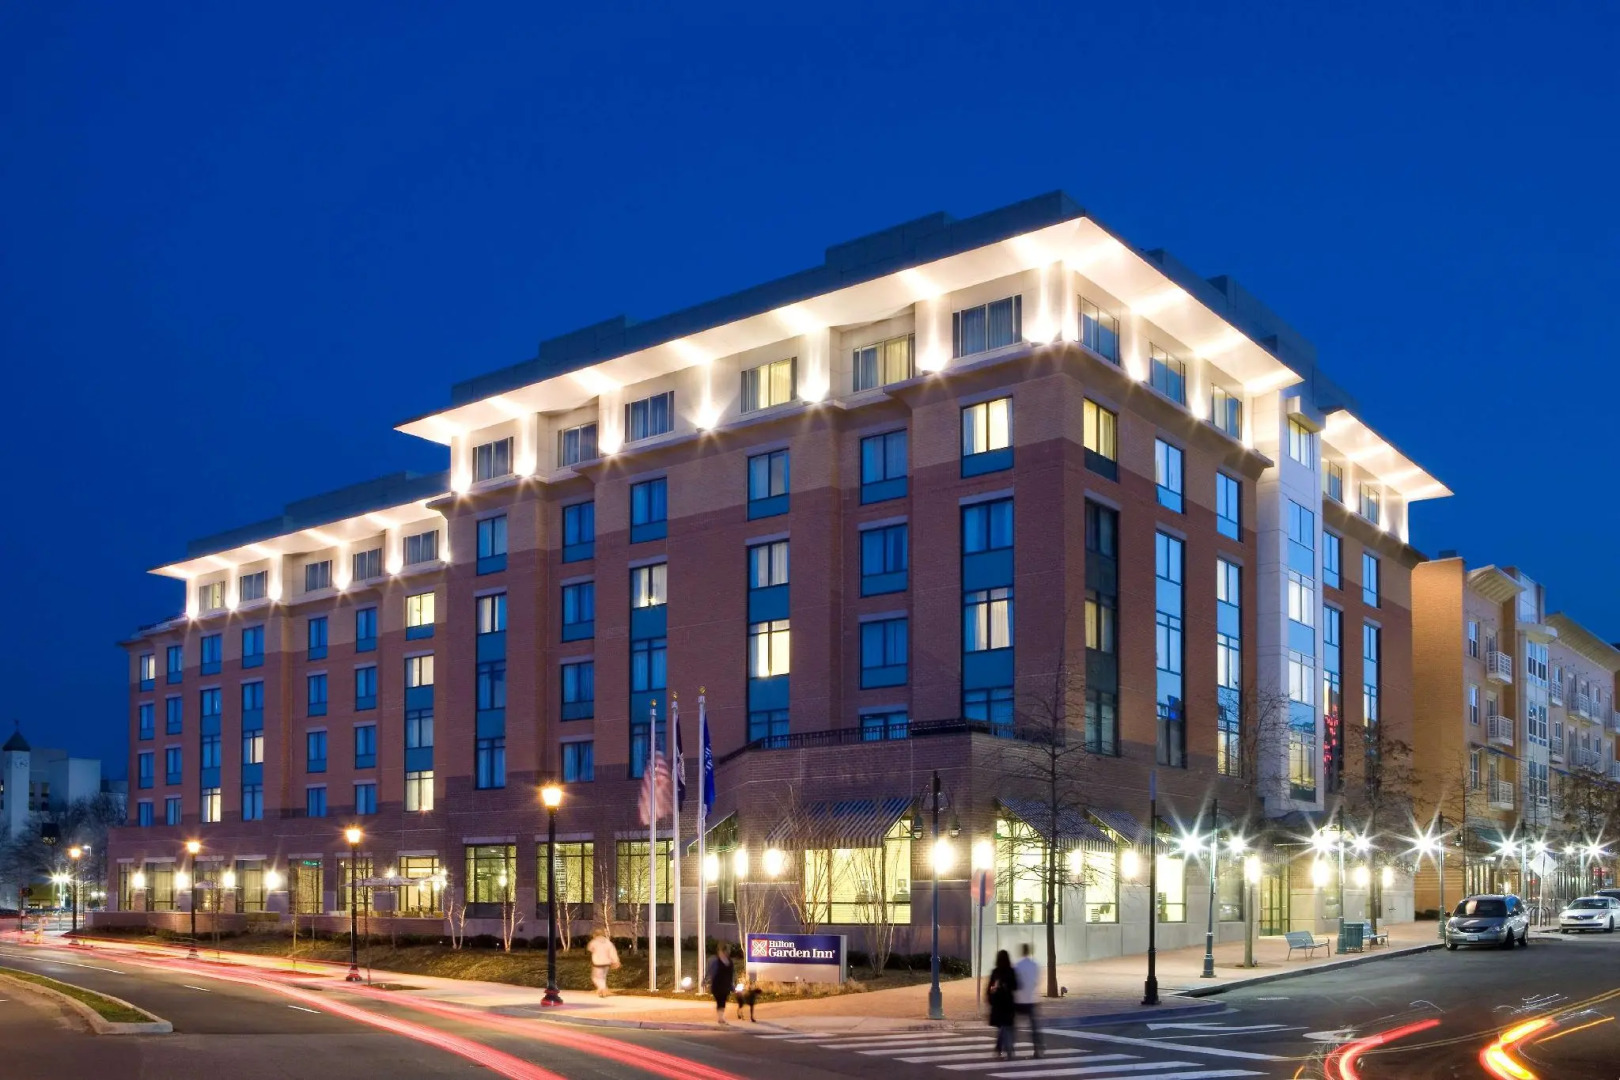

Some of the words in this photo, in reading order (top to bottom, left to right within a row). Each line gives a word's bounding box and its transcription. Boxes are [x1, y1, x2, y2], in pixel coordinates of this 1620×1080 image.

[768, 940, 795, 948] Hilton
[768, 947, 811, 958] Garden
[812, 948, 834, 959] Inn
